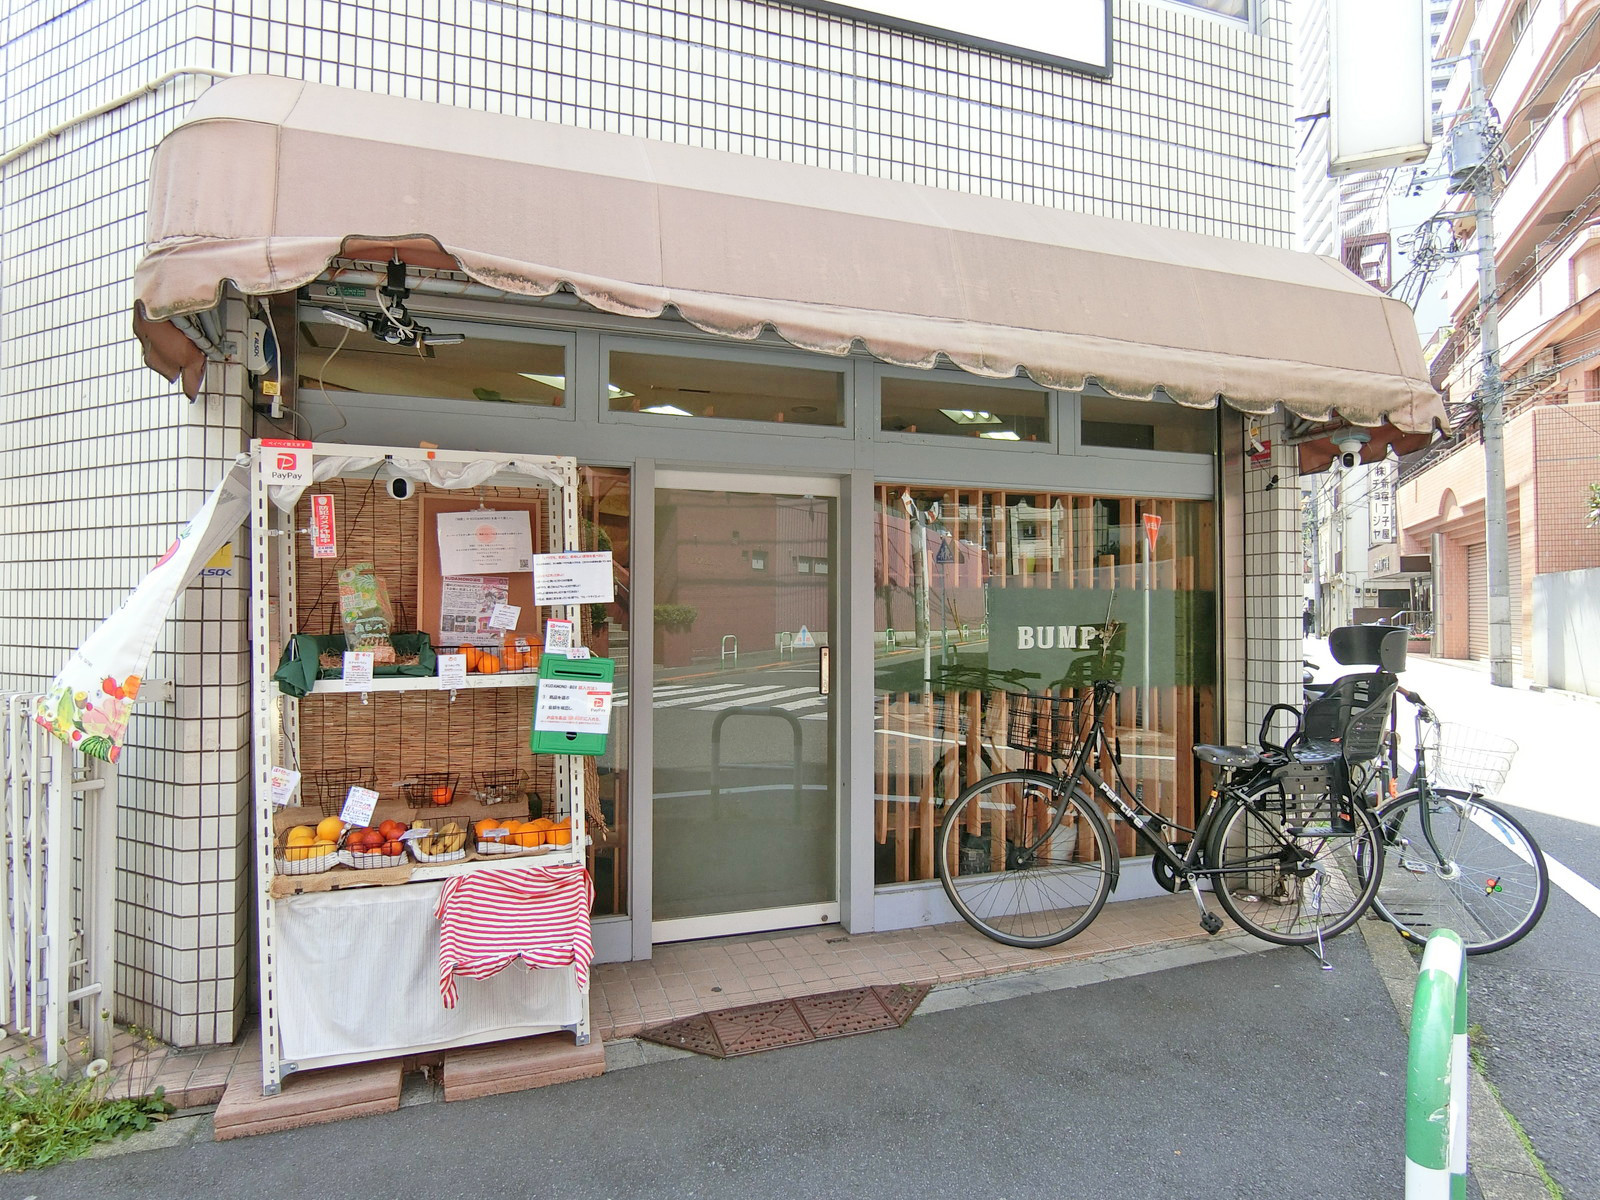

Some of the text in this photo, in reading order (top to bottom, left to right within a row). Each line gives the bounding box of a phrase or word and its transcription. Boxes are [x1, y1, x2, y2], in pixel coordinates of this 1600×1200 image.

[271, 471, 302, 480] PayPay
[1381, 479, 1390, 539] 新宿丁子屋
[318, 505, 330, 544] 防犯カメラ作動中
[198, 568, 233, 577] LSOK
